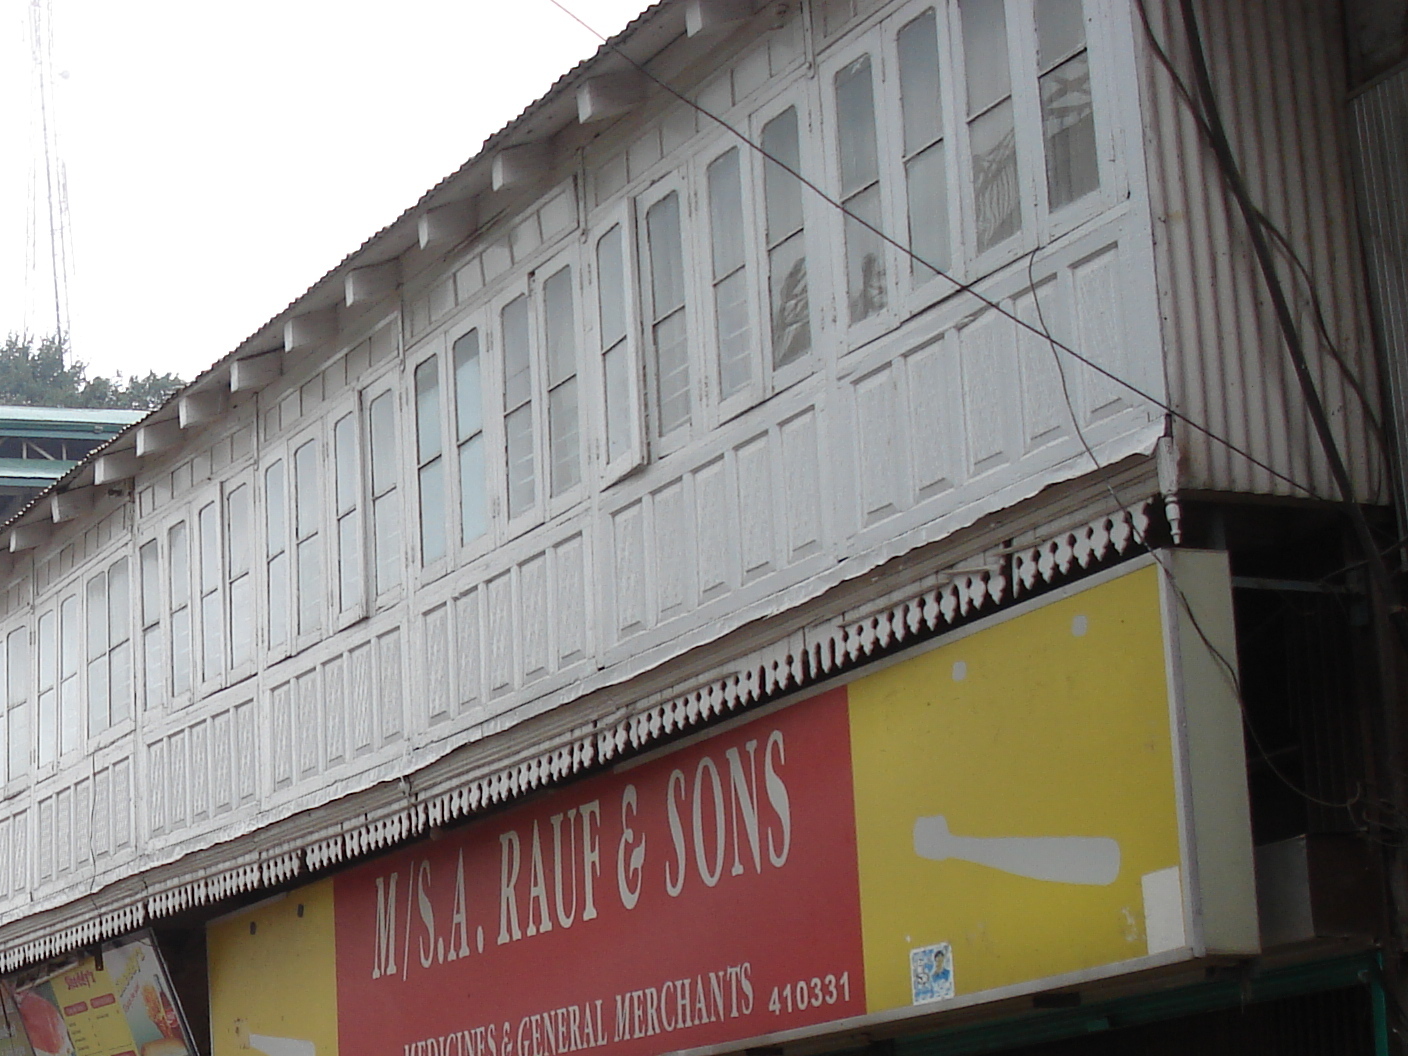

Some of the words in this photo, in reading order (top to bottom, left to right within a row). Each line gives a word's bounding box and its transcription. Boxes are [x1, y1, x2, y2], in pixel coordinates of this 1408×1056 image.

[497, 800, 601, 946] RAUF
[617, 784, 646, 910] &
[665, 730, 792, 898] SONS
[614, 962, 754, 1043] MERCHANTS
[768, 971, 851, 1016] 410331
